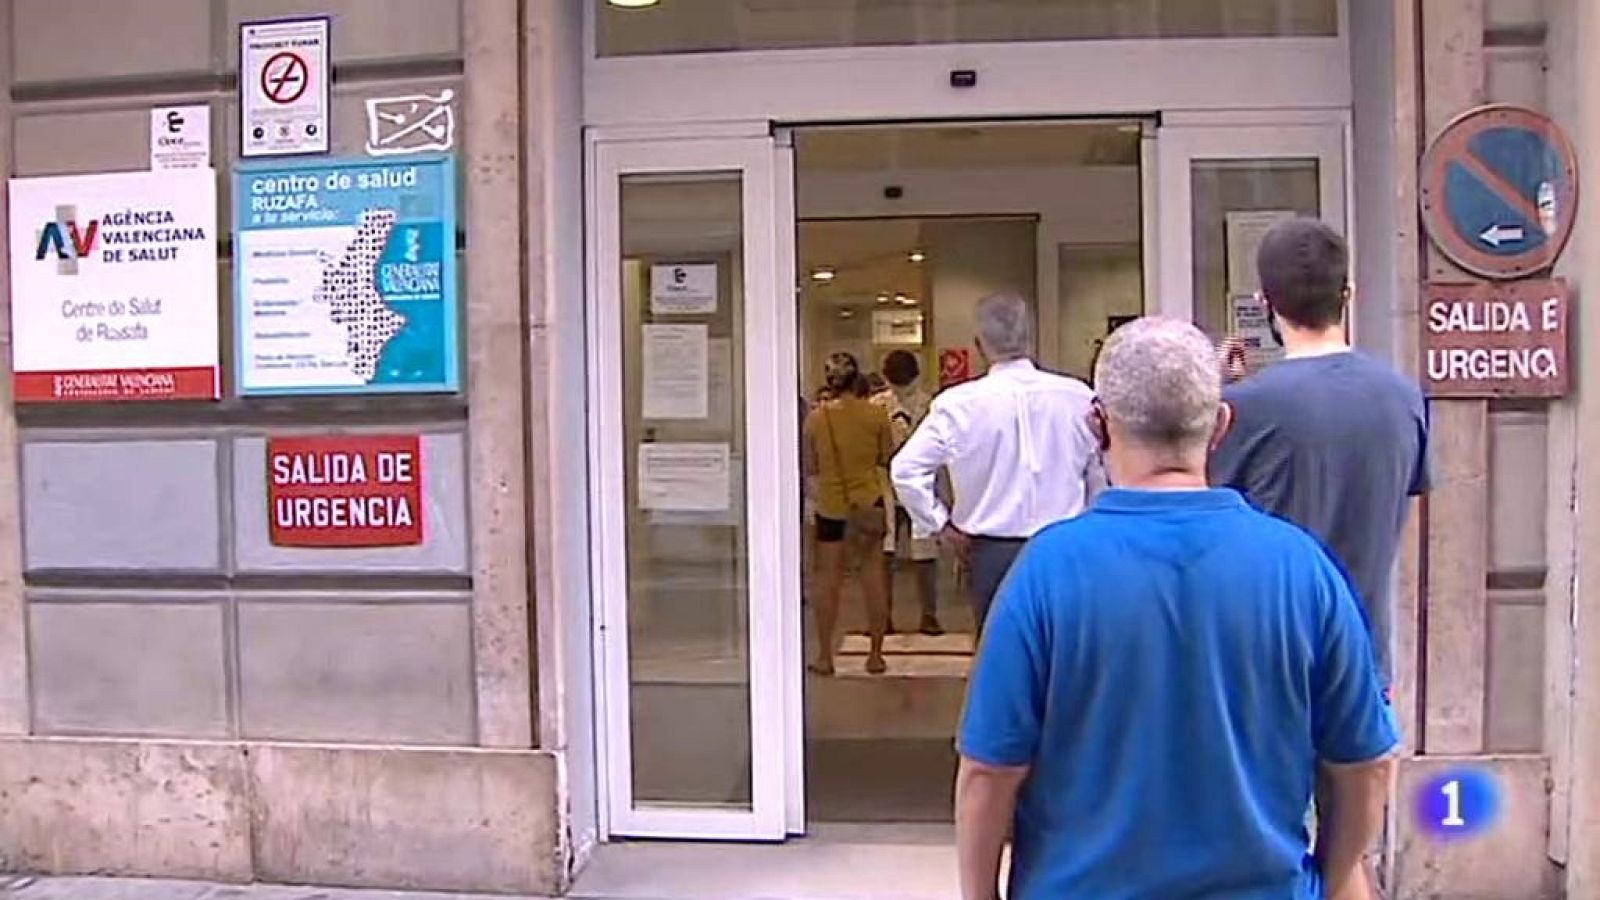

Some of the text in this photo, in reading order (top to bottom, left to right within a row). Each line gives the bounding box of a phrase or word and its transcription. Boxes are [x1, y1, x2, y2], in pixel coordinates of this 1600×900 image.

[252, 167, 416, 193] centro de salud
[252, 195, 317, 211] RUZAFA
[102, 228, 206, 244] VALENCIANA
[103, 247, 178, 263] DE SALUT
[1428, 301, 1531, 332] SALIDA
[274, 453, 412, 484] SALIDA DE
[277, 497, 412, 526] URGENCIA
